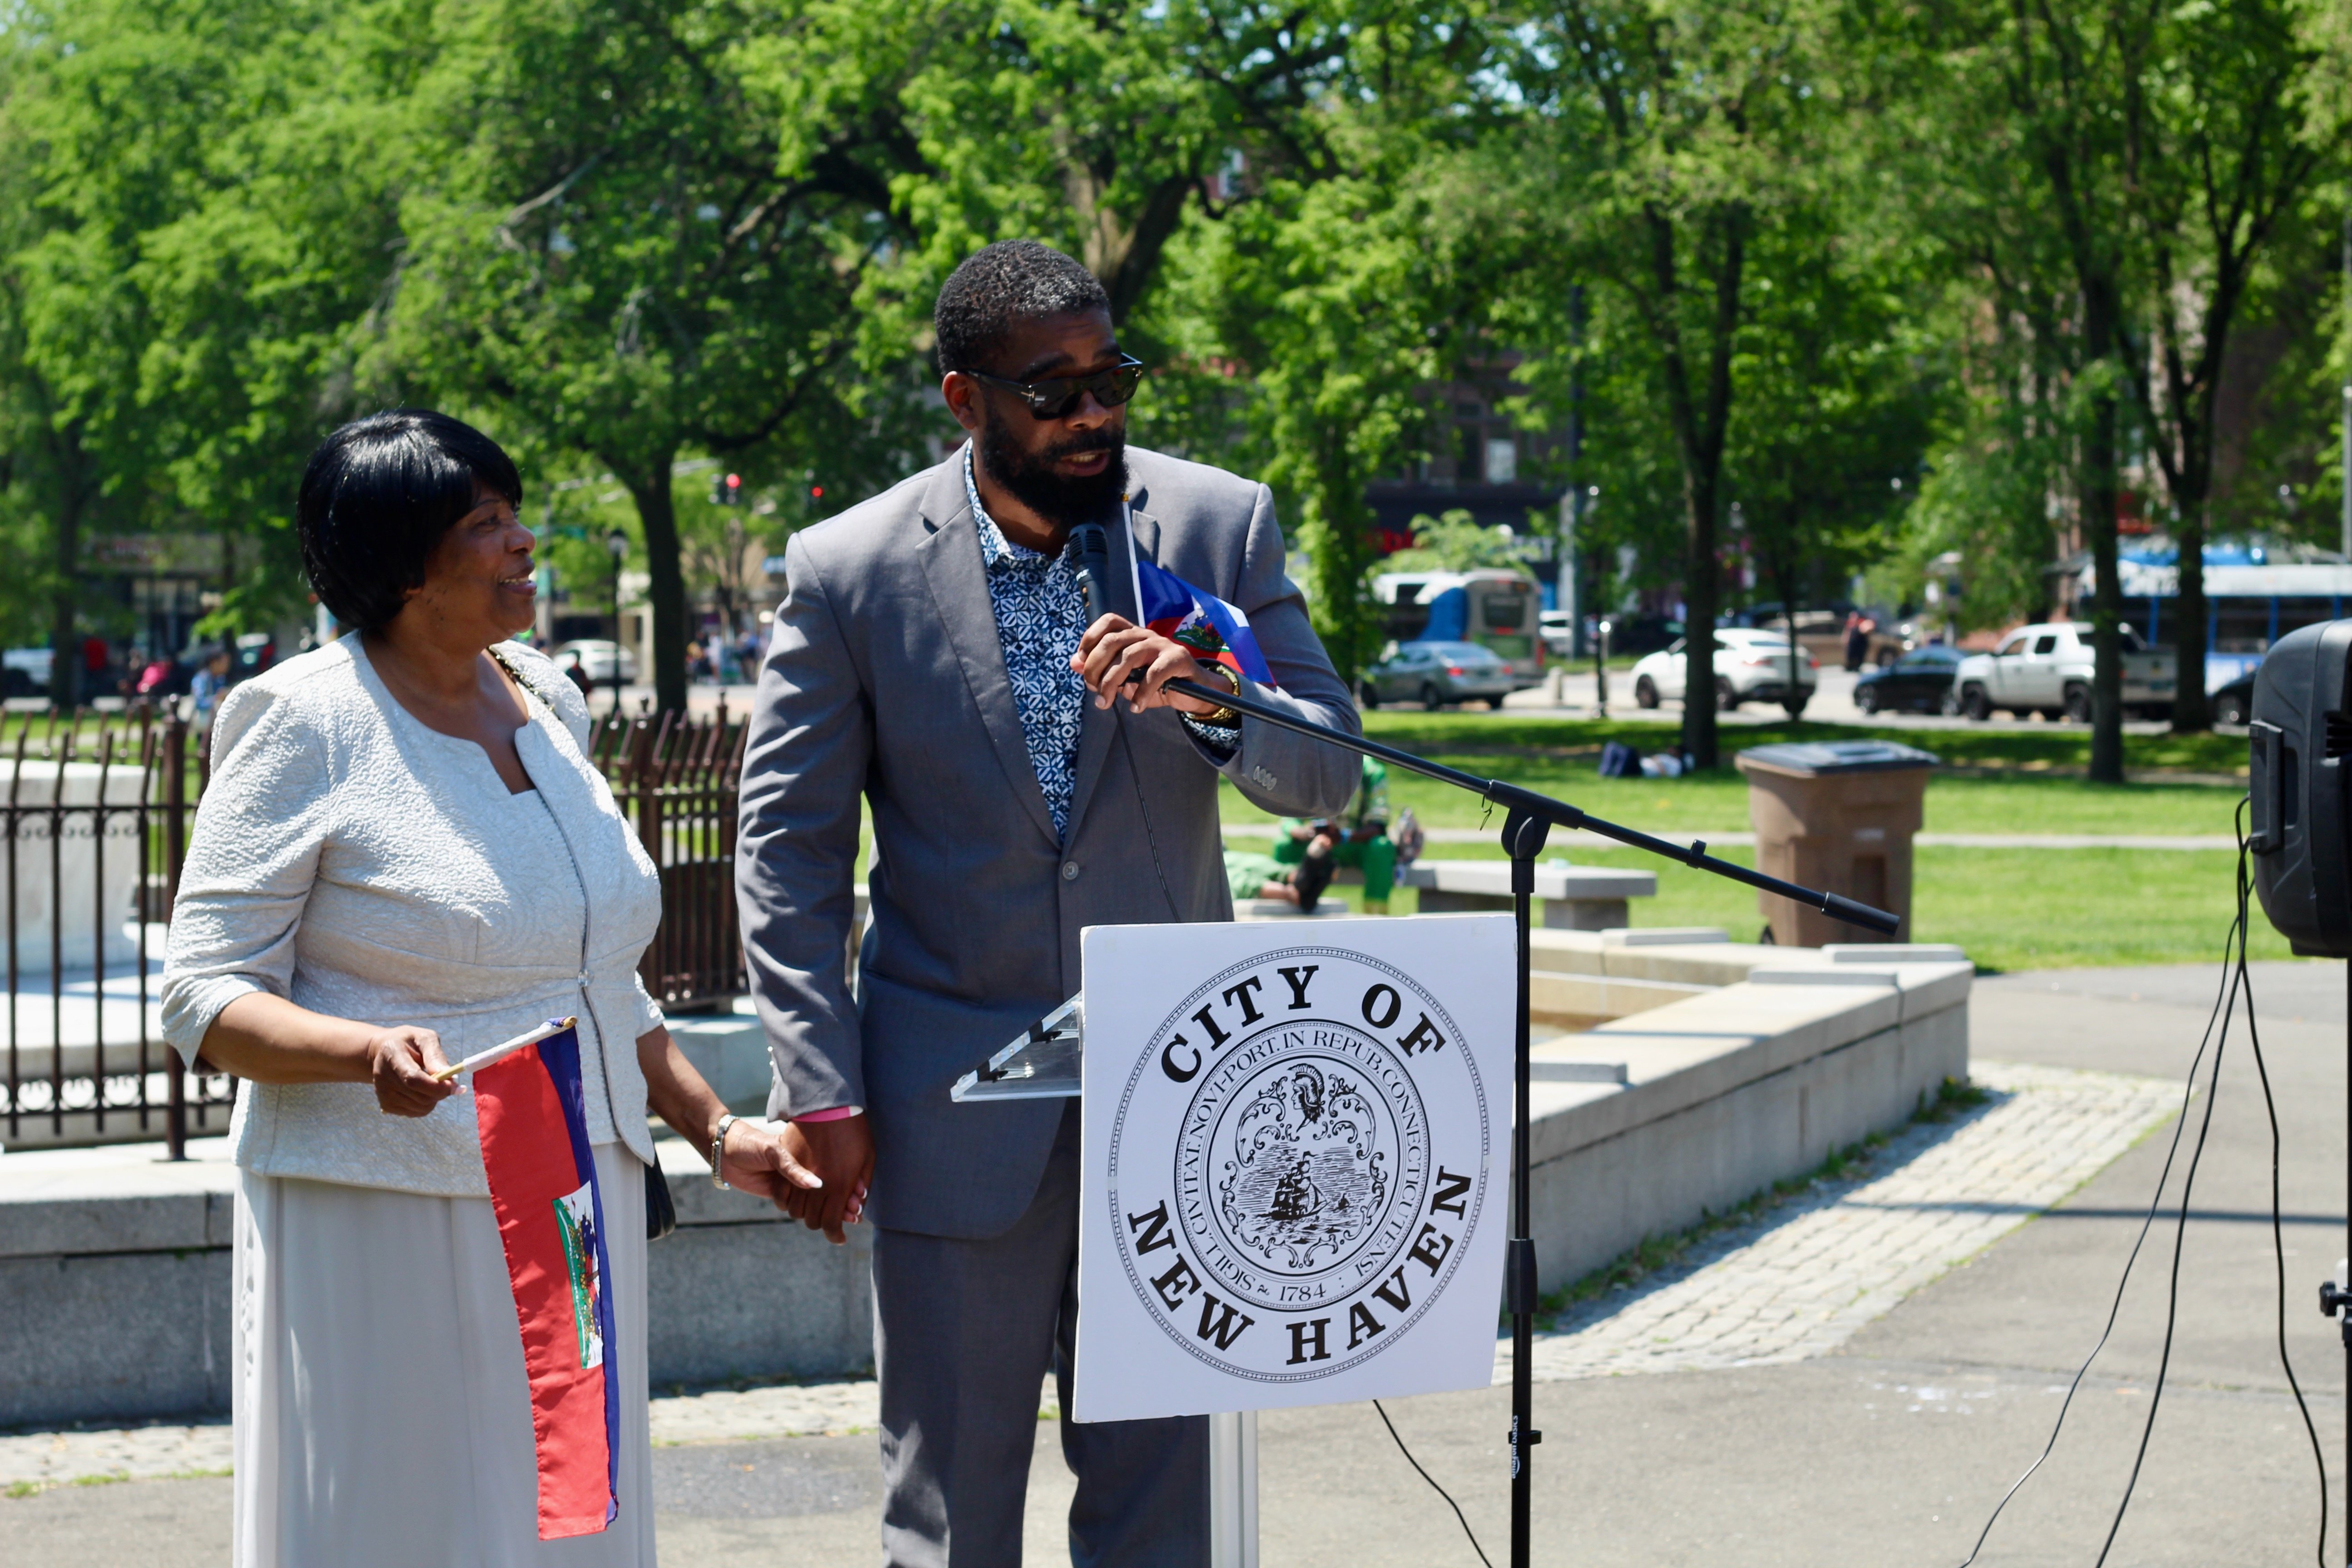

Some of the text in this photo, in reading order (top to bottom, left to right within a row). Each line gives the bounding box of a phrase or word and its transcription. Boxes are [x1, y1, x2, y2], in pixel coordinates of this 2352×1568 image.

[1161, 965, 1447, 1083] CITY OF
[1283, 1030, 1304, 1049] IN
[1313, 1030, 1382, 1073] REPUB.
[1127, 1166, 1472, 1365] NEW HAVEN
[1279, 1283, 1326, 1301] 1784
